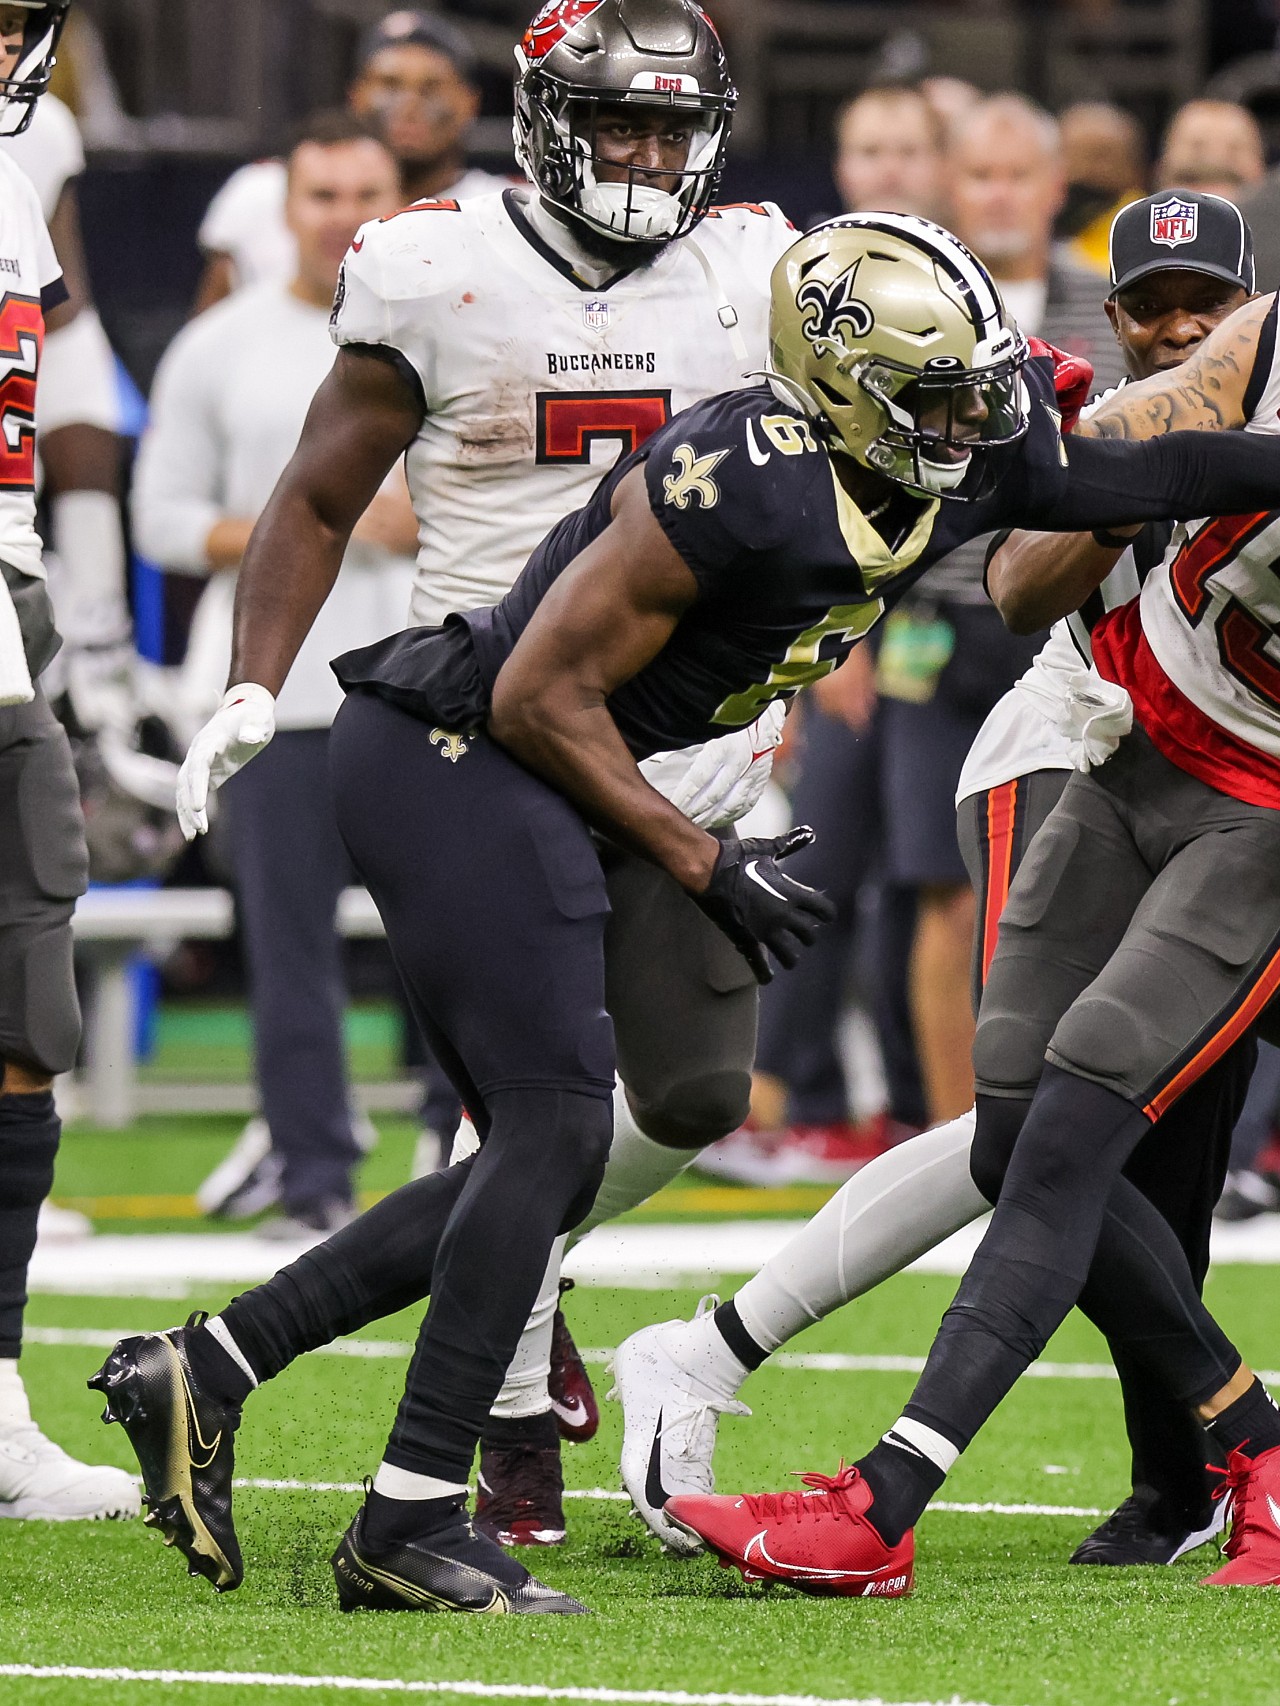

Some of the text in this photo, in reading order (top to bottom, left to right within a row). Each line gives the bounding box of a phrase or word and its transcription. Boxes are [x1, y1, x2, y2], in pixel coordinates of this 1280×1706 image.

[1155, 218, 1191, 240] NFL
[588, 312, 607, 326] NFL
[546, 352, 656, 375] BUCCANEERS
[536, 389, 674, 472] 7
[760, 414, 818, 456] 6
